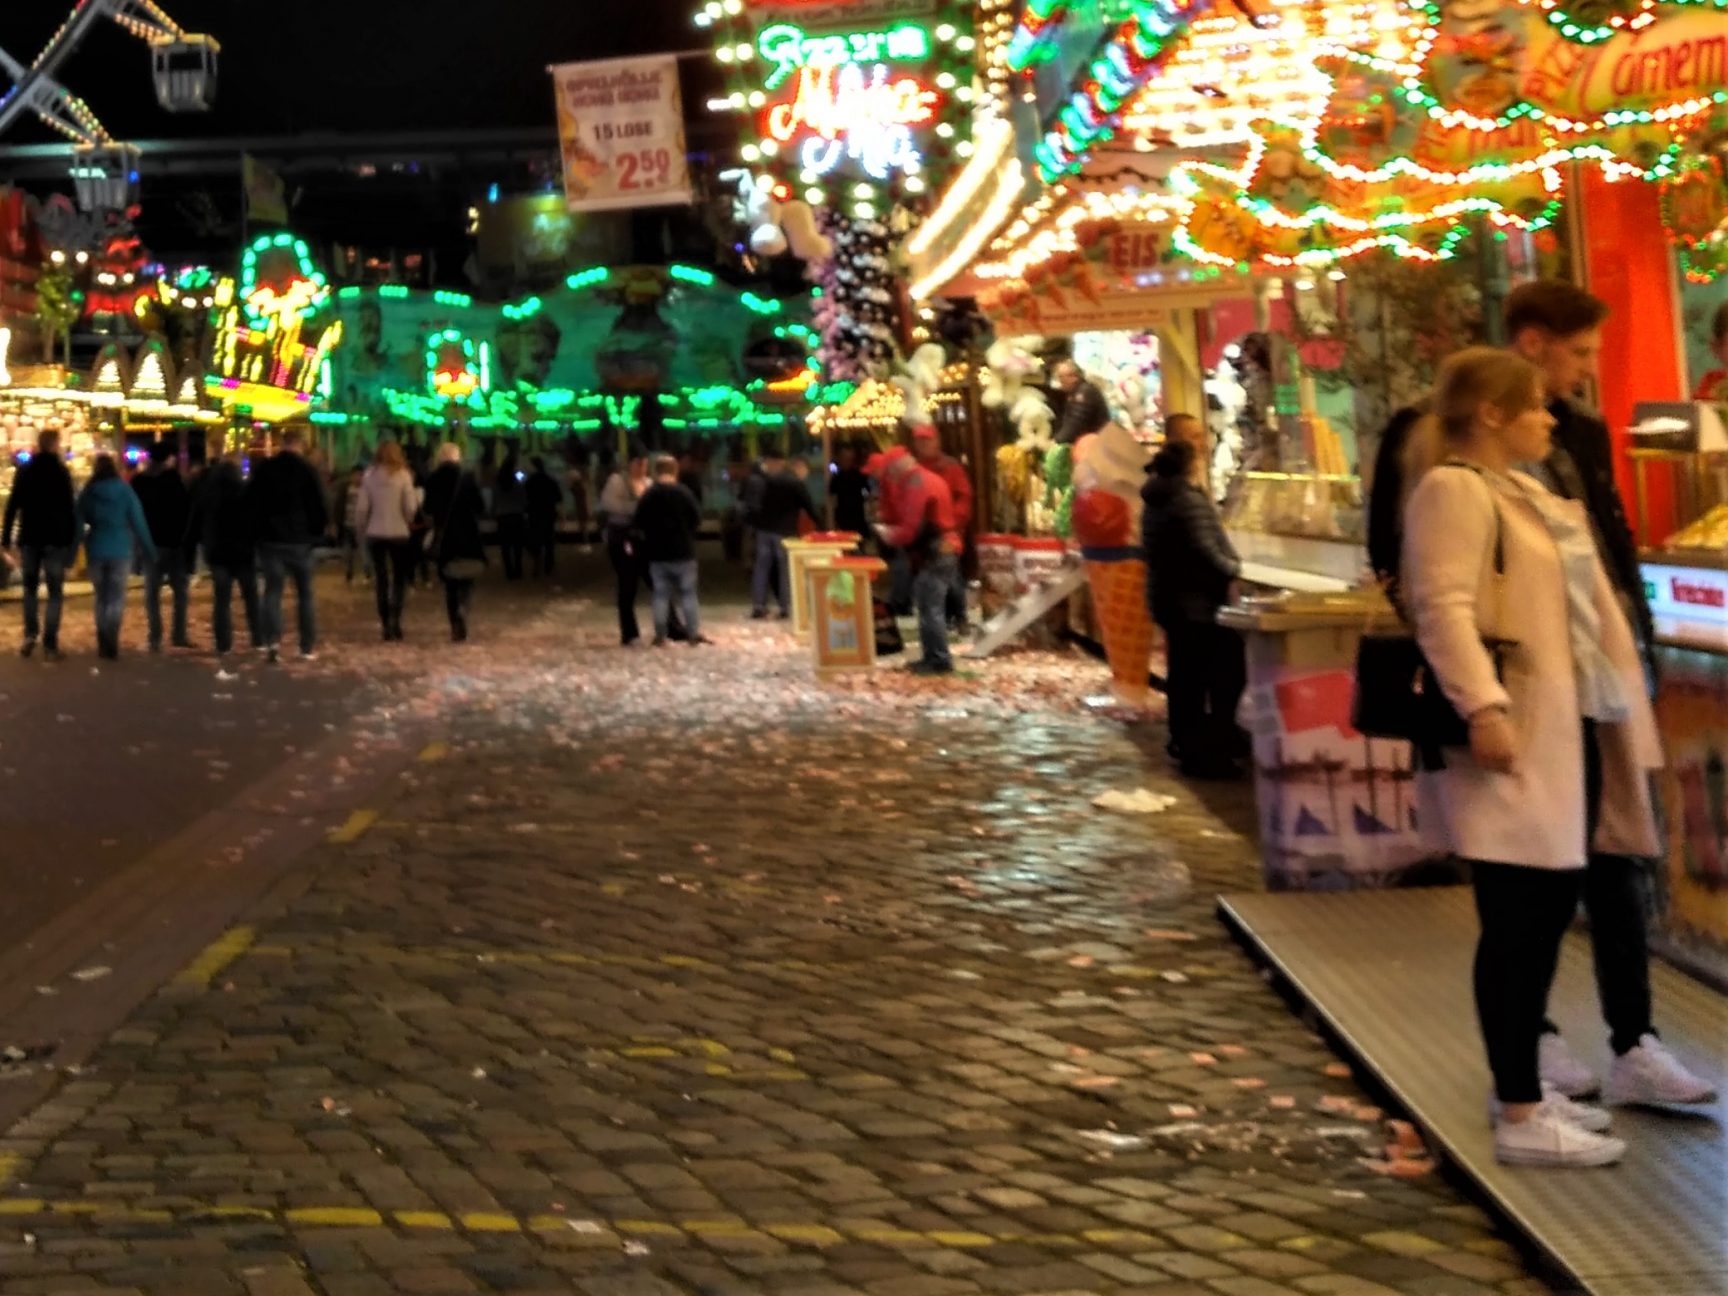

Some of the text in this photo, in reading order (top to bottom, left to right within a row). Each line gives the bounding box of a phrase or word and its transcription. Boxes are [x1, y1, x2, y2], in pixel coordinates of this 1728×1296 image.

[593, 120, 653, 141] 15 LOSE
[1111, 232, 1161, 271] EIS
